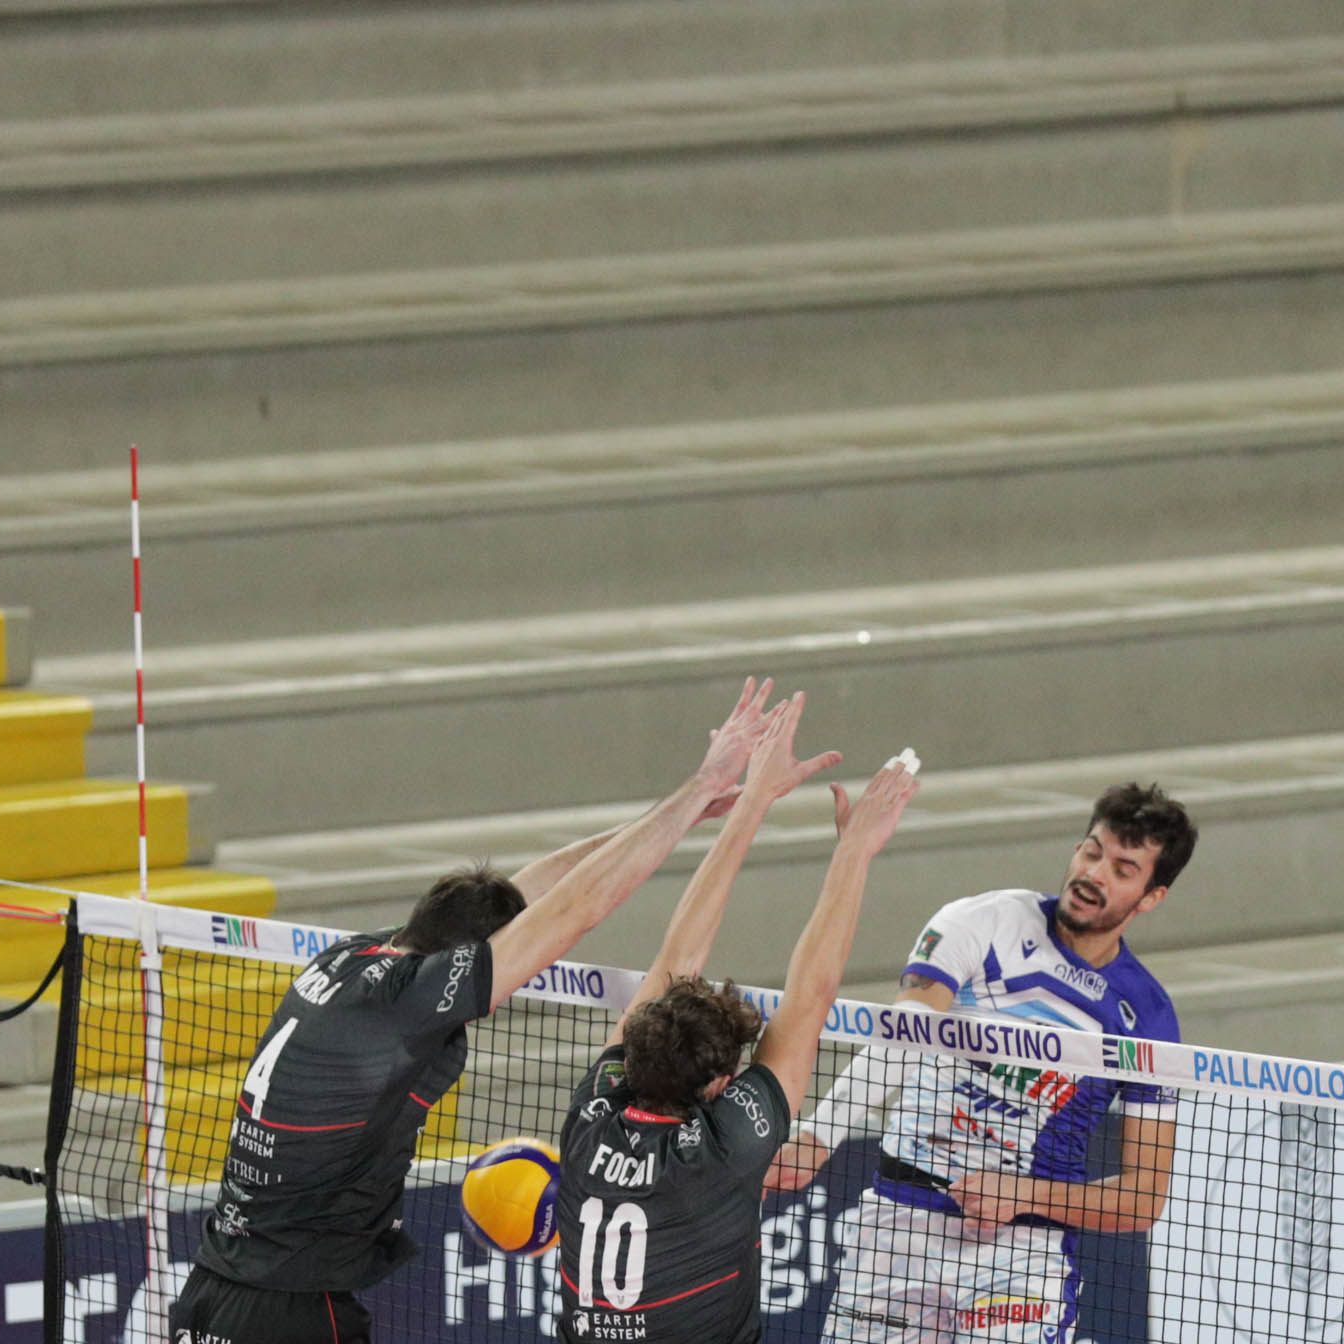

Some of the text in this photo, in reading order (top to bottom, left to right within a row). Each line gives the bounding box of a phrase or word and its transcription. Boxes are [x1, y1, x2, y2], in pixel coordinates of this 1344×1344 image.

[880, 1009, 931, 1045] SAN
[938, 1018, 1062, 1062] GIUSTINO
[243, 1017, 299, 1120] 4
[240, 1124, 275, 1145] EARTH
[238, 1137, 273, 1158] SYSTEM
[578, 1196, 648, 1310] 10
[593, 1313, 646, 1326] EARTH
[595, 1327, 646, 1340] SYSTEM
